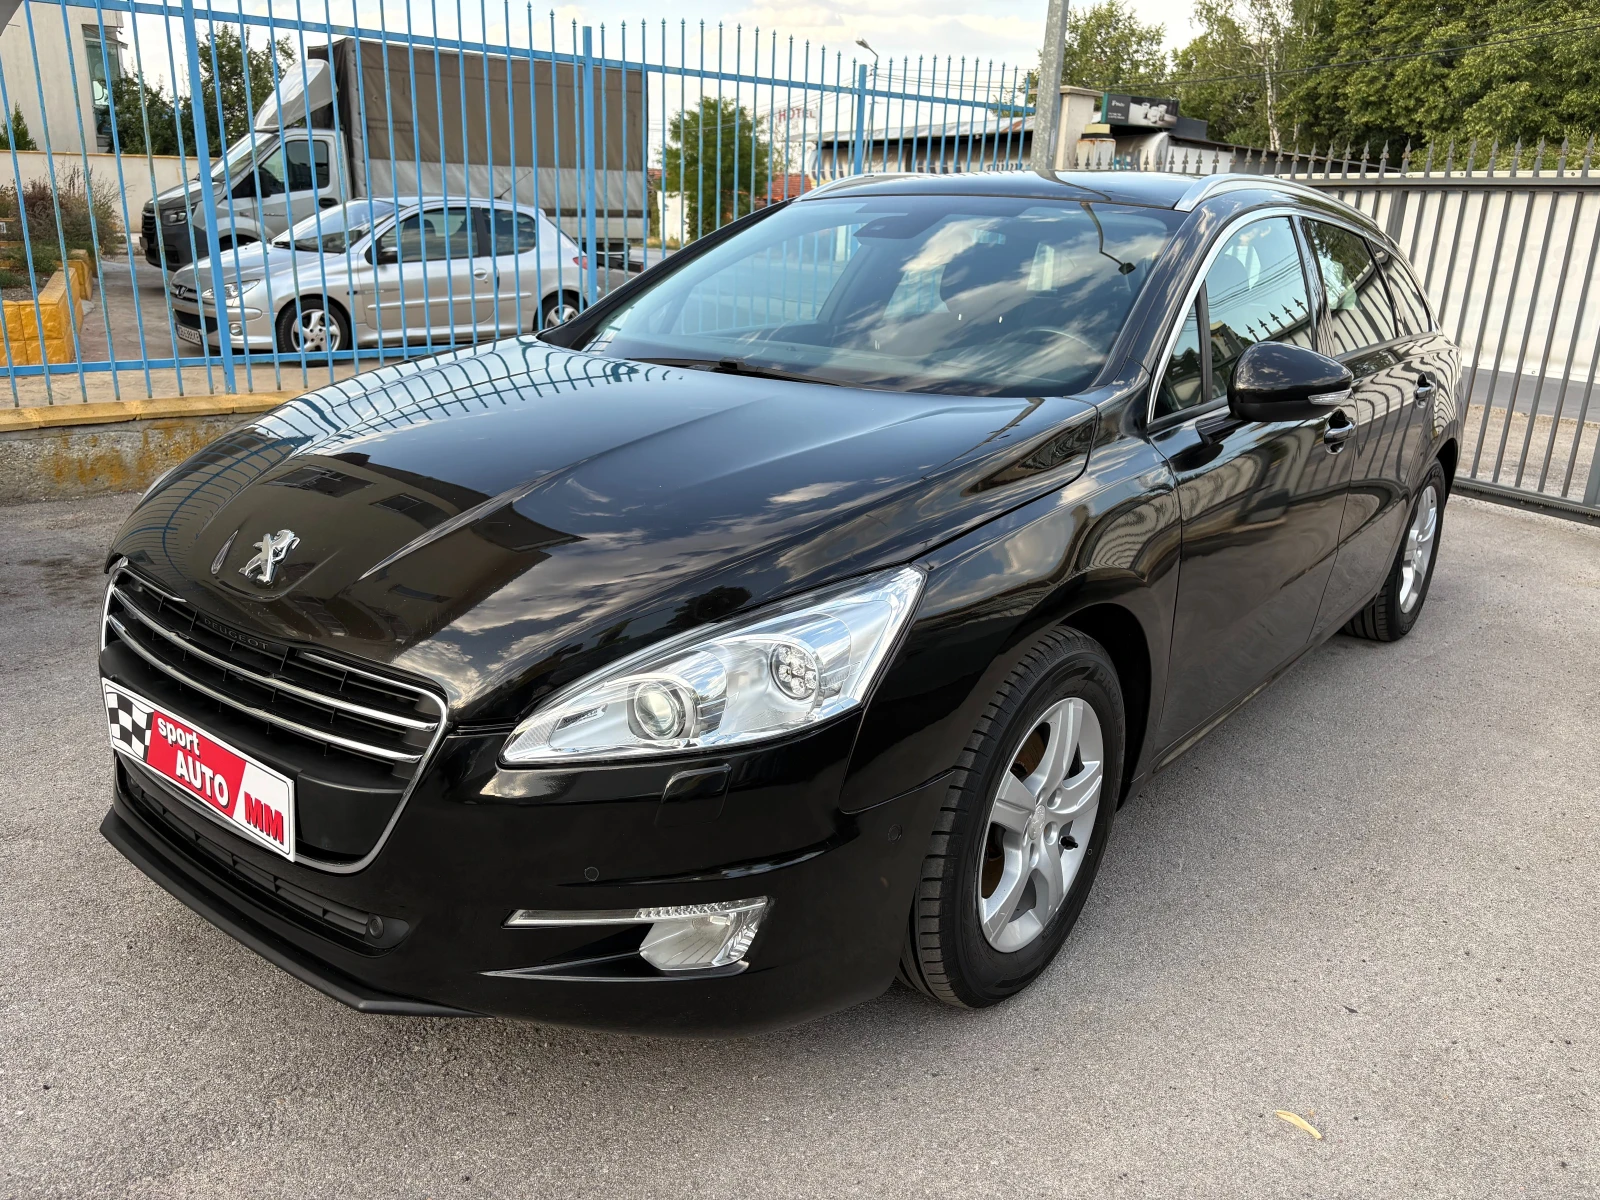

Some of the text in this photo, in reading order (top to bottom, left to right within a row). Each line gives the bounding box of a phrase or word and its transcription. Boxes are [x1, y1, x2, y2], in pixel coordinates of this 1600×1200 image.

[778, 107, 816, 123] HOTEL
[204, 618, 268, 650] PEUGEOT
[157, 717, 200, 756] sport
[175, 749, 230, 809] AUTO
[244, 790, 284, 846] MM
